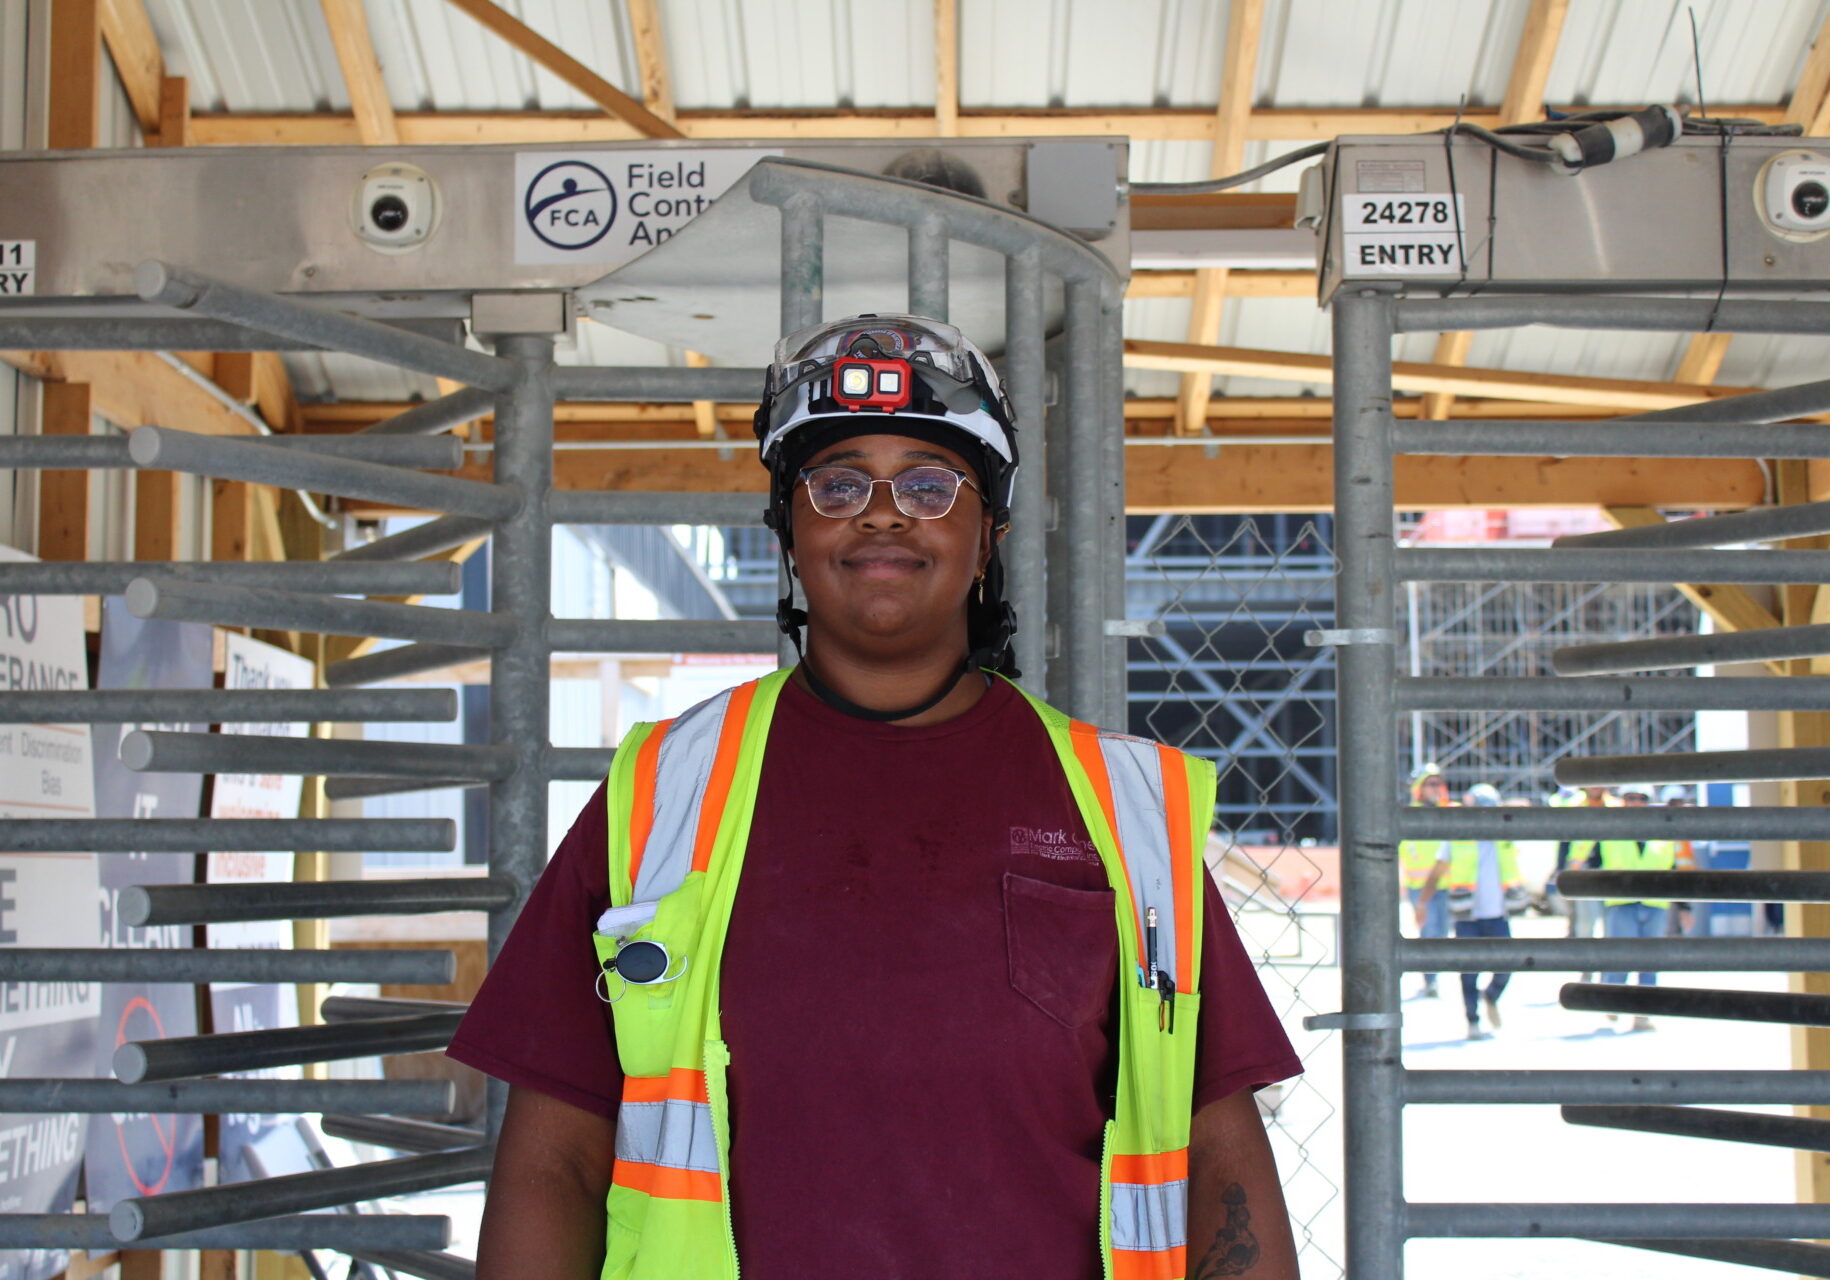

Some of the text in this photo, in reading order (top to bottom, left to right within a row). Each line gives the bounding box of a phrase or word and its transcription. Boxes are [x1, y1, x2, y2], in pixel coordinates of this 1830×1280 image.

[627, 162, 704, 188] Field
[550, 209, 599, 227] FCA
[1362, 201, 1448, 224] 24278
[1360, 244, 1454, 265] ENTRY
[1029, 828, 1067, 844] Mark
